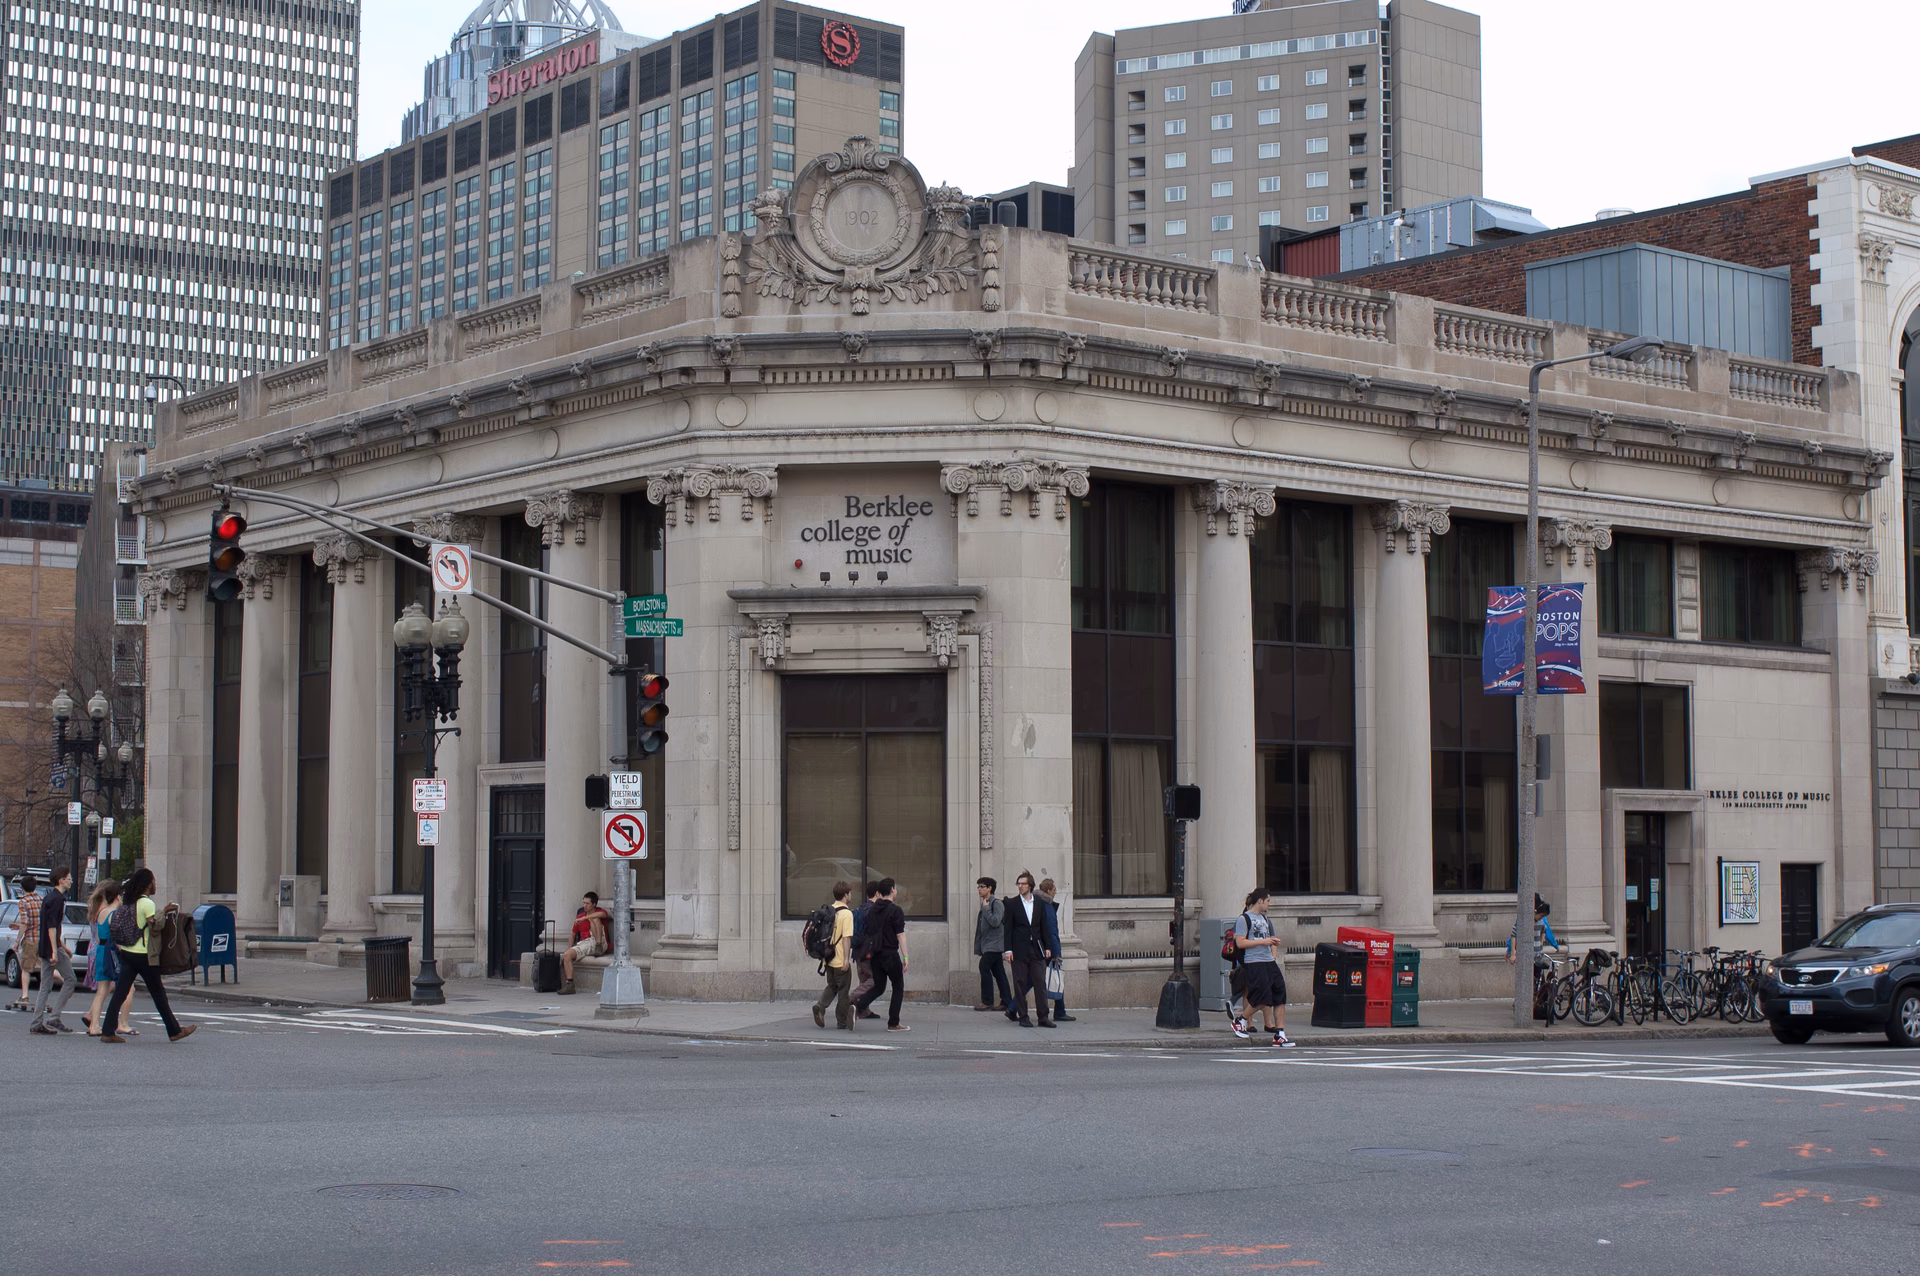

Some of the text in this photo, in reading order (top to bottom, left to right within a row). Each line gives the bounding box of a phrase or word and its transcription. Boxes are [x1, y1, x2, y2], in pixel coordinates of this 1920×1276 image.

[831, 28, 850, 55] S
[488, 40, 597, 104] Sheraton
[845, 210, 878, 225] 1902
[844, 494, 933, 518] Berklee
[801, 517, 913, 547] college of
[845, 548, 912, 564] music
[633, 599, 660, 611] BOYLSTON
[1537, 611, 1579, 621] BOSTON
[636, 620, 676, 634] MASSACHUSETTS
[1535, 622, 1578, 641] POPS
[613, 775, 638, 784] YIELD
[1706, 790, 1830, 801] RKLEE COLLEGE OF MUSIC
[1370, 940, 1390, 948] Phoenix
